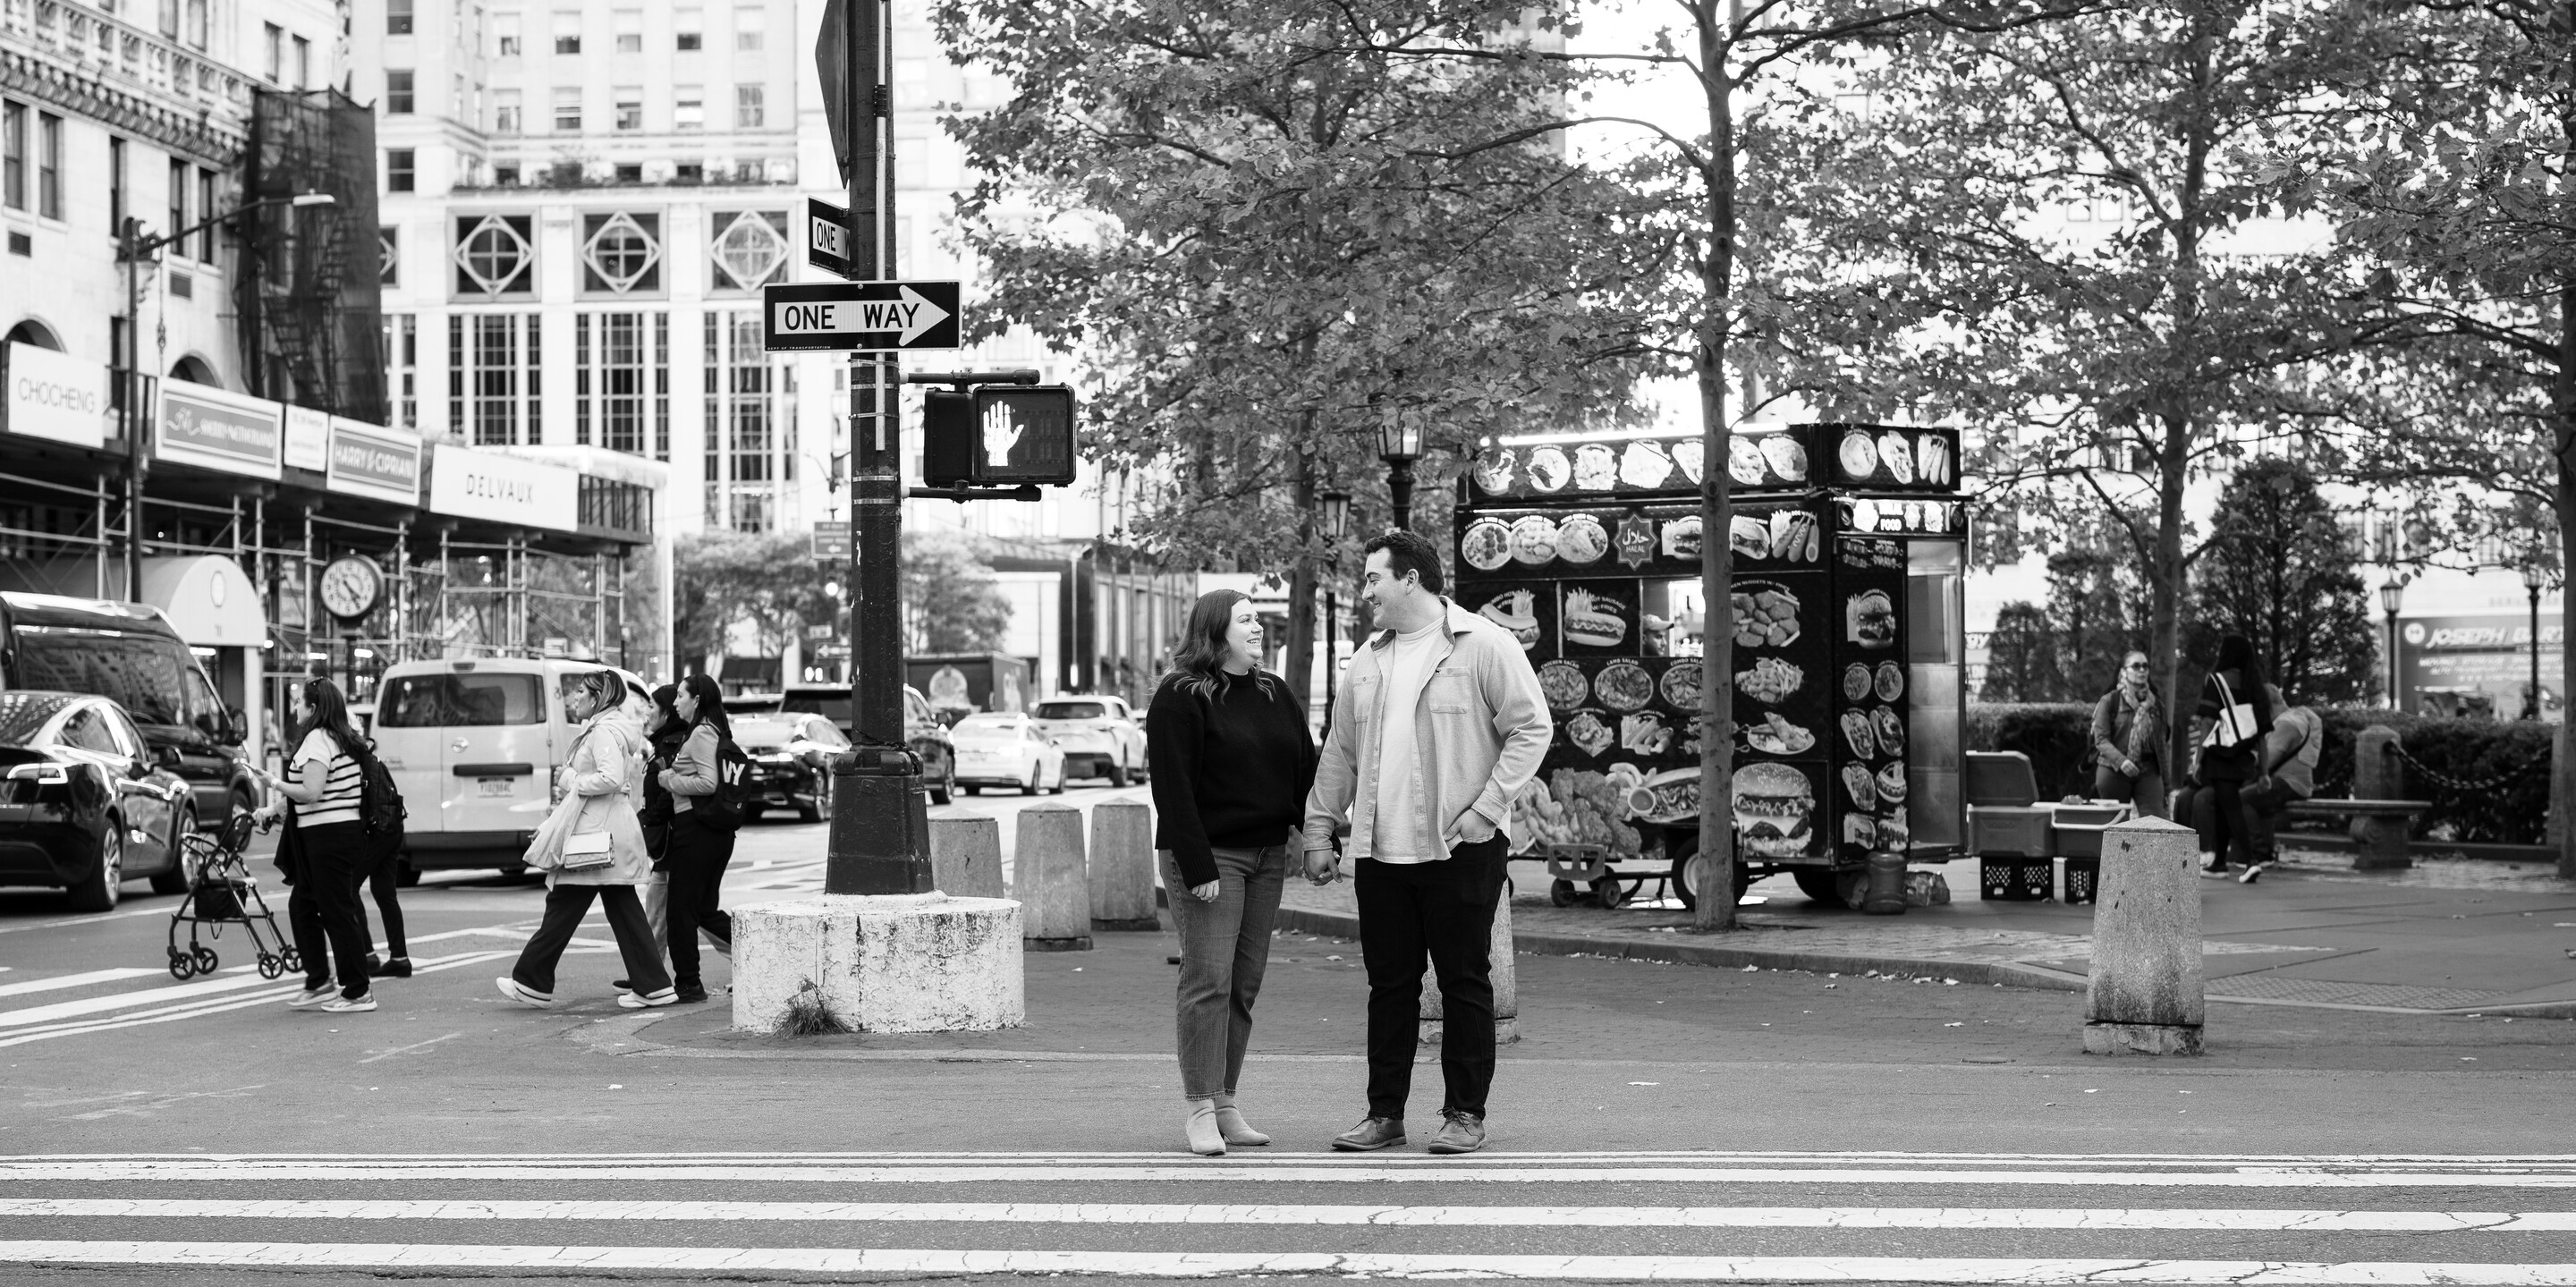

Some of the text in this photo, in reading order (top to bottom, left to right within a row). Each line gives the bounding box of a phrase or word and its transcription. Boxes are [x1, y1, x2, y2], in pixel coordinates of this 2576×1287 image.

[817, 221, 836, 252] ONE
[784, 302, 920, 331] ONE WAY
[18, 377, 95, 414] CHOCHENG
[335, 444, 366, 470] HARRY
[466, 473, 534, 504] DELVAUX
[1880, 518, 1902, 532] FOOD
[1622, 528, 1649, 546] حلال
[1625, 545, 1646, 553] HALAL
[1600, 605, 1617, 614] FRIES
[1601, 597, 1627, 611] SAUSAGE
[2425, 627, 2508, 649] JOSEPH
[1540, 659, 1563, 670] CHICKEN
[1606, 658, 1621, 666] LAMB
